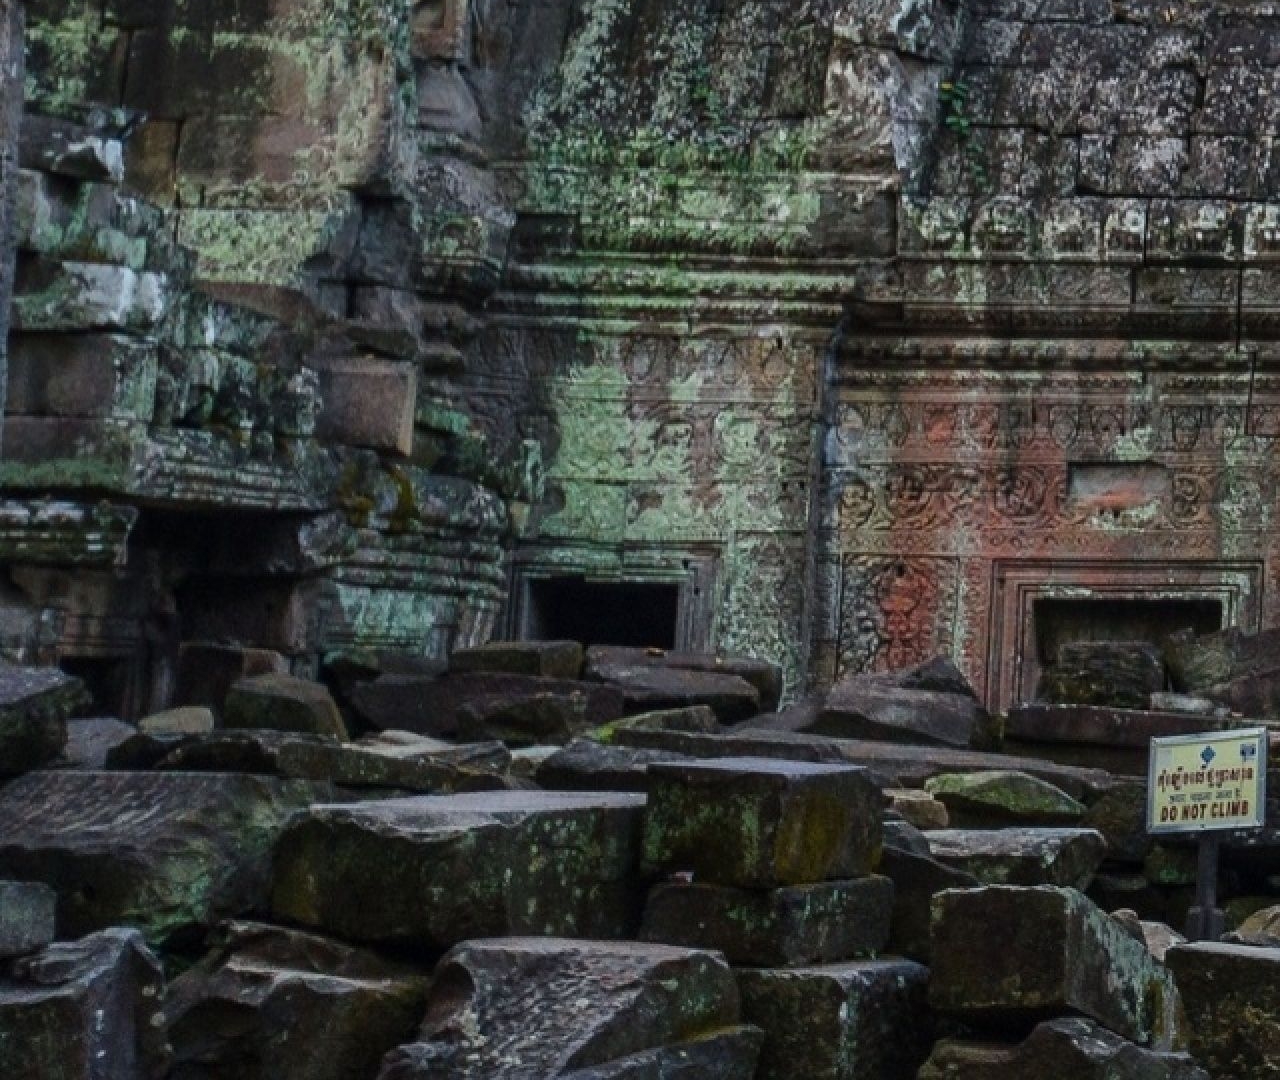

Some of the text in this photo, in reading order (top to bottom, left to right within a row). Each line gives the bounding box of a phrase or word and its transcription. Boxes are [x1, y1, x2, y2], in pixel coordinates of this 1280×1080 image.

[1161, 801, 1248, 822] DO NOT CLIMB
